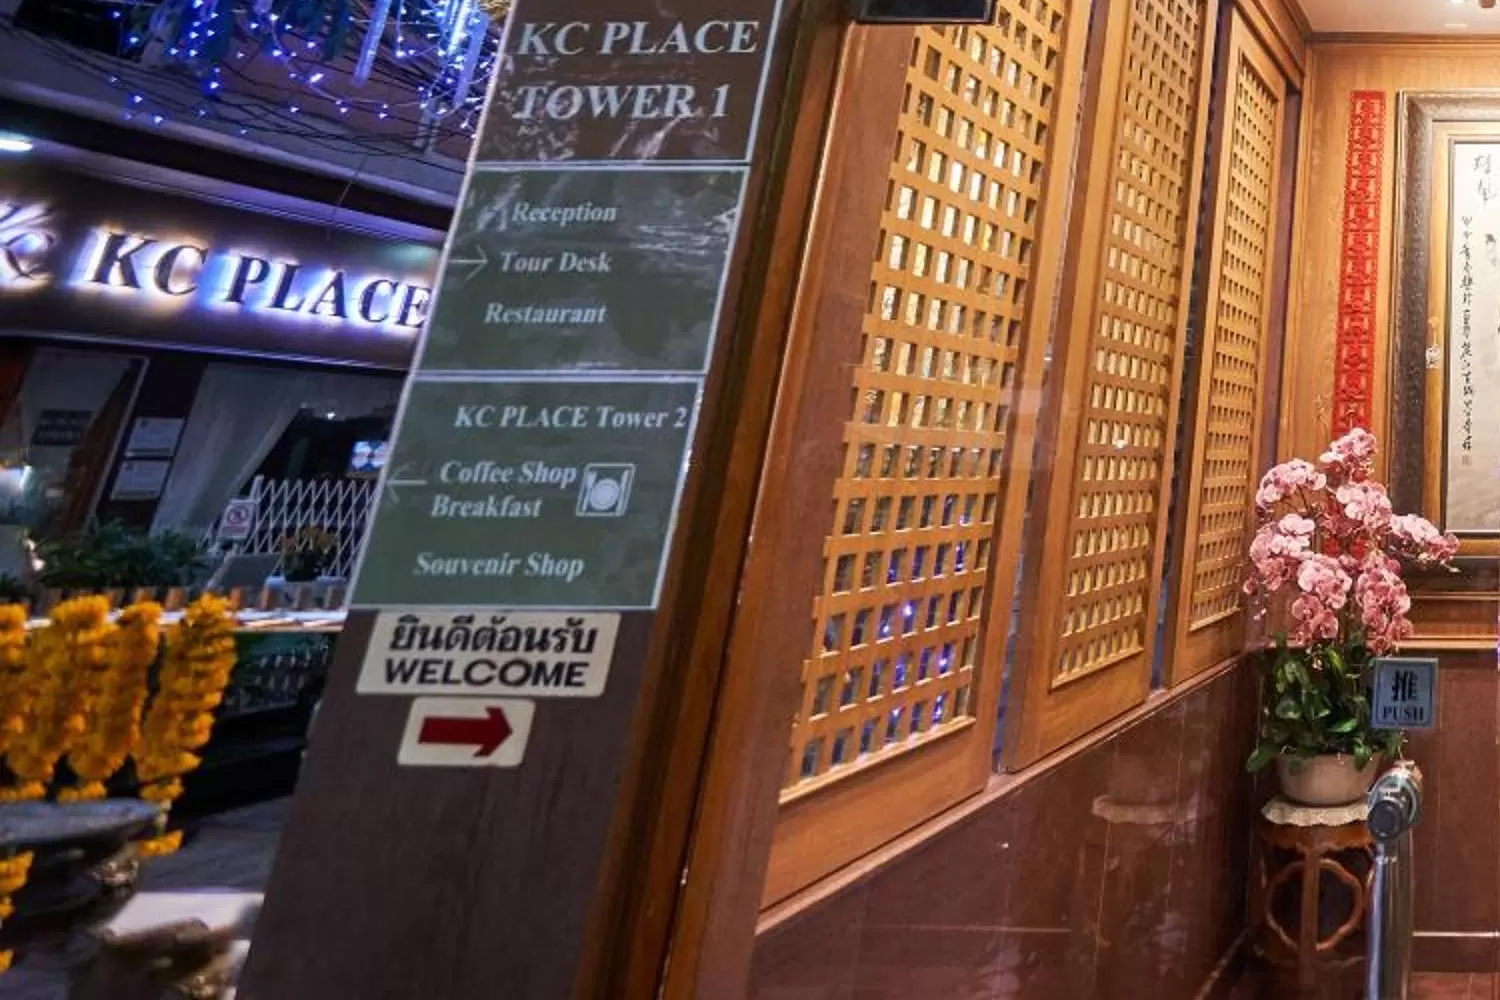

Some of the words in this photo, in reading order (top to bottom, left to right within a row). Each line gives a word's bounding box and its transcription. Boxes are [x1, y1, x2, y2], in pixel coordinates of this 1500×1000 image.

[518, 21, 592, 56] KC
[600, 21, 759, 55] PLACE
[513, 83, 697, 120] TOWER
[713, 85, 732, 118] 1
[512, 201, 617, 227] Reception
[502, 253, 551, 272] Tour
[558, 252, 612, 273] Desk
[89, 231, 209, 296] KC
[223, 255, 431, 329] PLACE
[485, 302, 607, 324] Restaurant
[454, 406, 494, 428] KC
[499, 406, 588, 428] PLACE
[597, 406, 667, 428] Tower
[675, 406, 689, 428] 2
[440, 461, 516, 484] Coffee
[519, 461, 577, 490] Shop
[431, 495, 541, 519] Breakfast
[413, 552, 519, 577] Souvenir
[525, 552, 585, 582] Shop
[389, 614, 598, 654] ยินดีต้อนรับ
[384, 659, 590, 688] WELCOME
[1391, 669, 1418, 701] 推
[1381, 704, 1424, 721] PUSH
